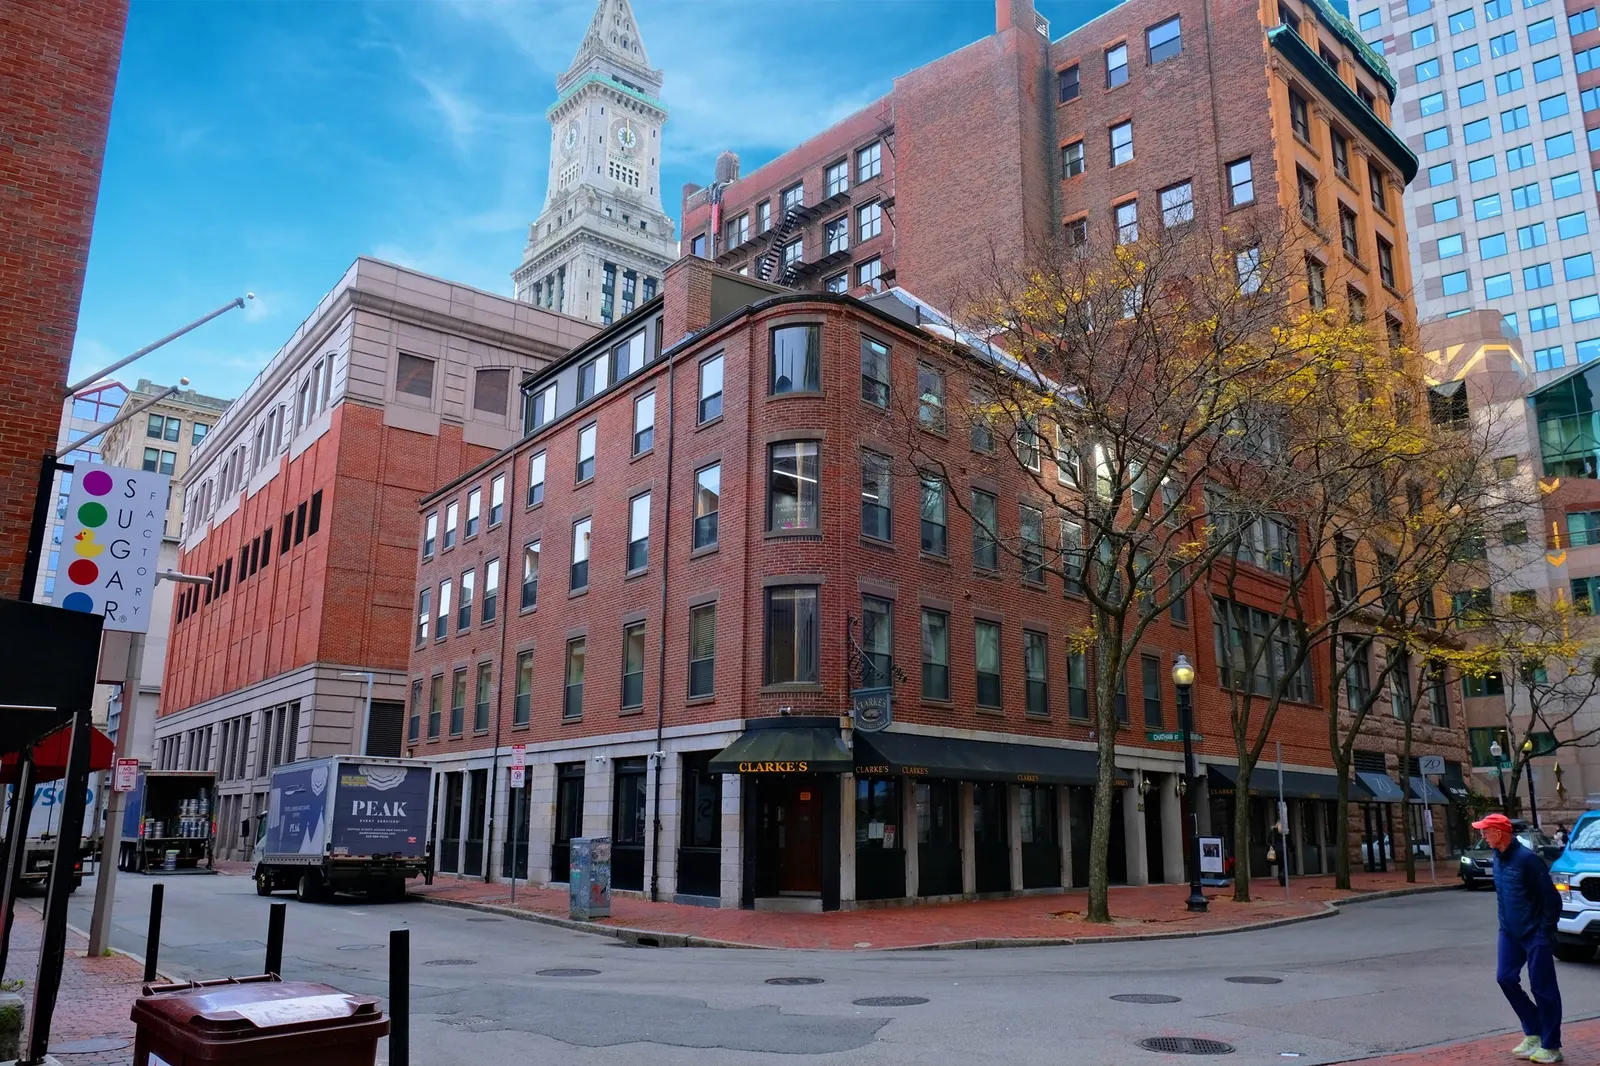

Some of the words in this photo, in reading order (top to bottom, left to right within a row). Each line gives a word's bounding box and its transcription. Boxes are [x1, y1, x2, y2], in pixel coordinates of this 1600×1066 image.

[104, 479, 136, 621] SUGAR
[133, 492, 156, 615] FACTORY
[856, 697, 887, 711] CLARKE'S
[1153, 733, 1173, 741] CHATHAM
[739, 761, 808, 772] CLARKE'S
[855, 765, 889, 774] CLARKE'S
[902, 766, 929, 775] CLARKE'S
[1017, 774, 1040, 782] CLARKE'S
[351, 800, 408, 817] PEAK
